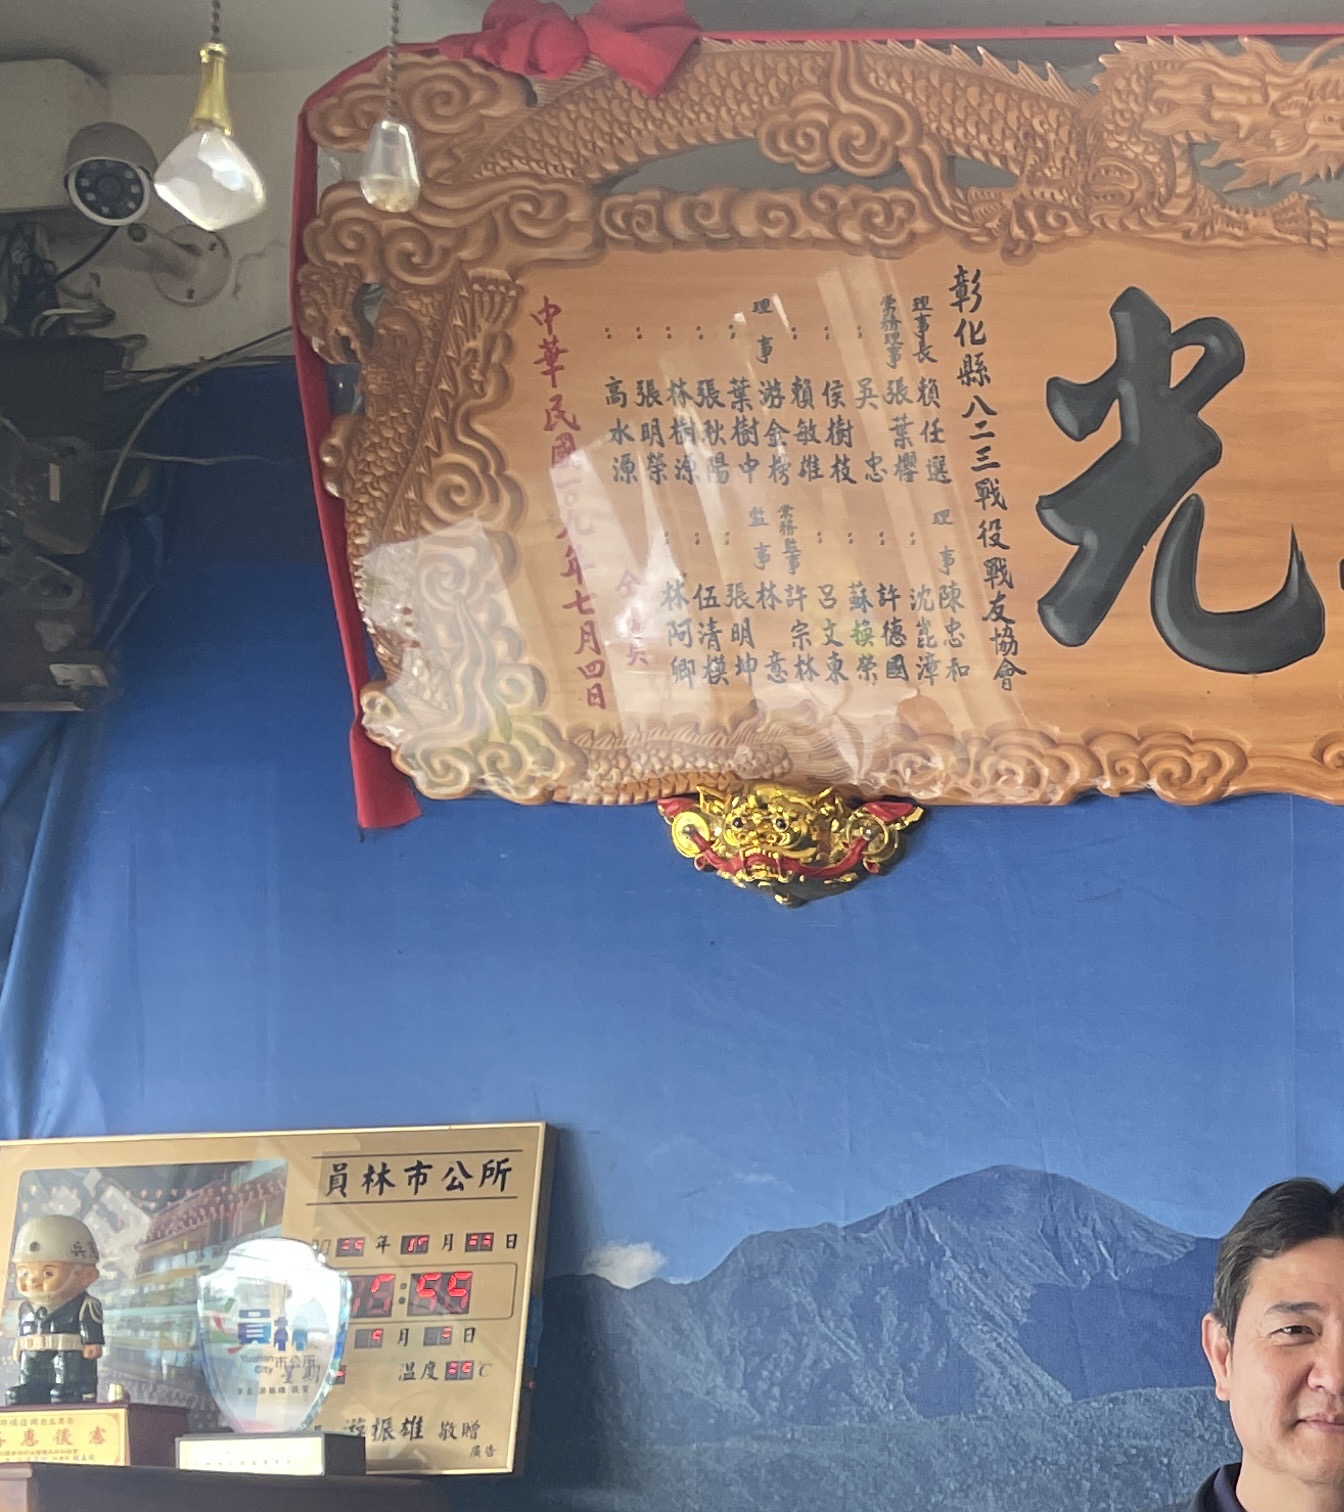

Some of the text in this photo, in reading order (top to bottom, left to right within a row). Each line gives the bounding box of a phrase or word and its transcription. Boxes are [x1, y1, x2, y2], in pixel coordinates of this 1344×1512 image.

[911, 295, 938, 364] 理事長
[789, 375, 824, 483] 賴敏雄
[948, 264, 1027, 692] 彰化縣八二三戰役戰友協會
[325, 1157, 513, 1198] 員林市公所
[441, 1233, 454, 1252] 月
[505, 1233, 518, 1250] 日
